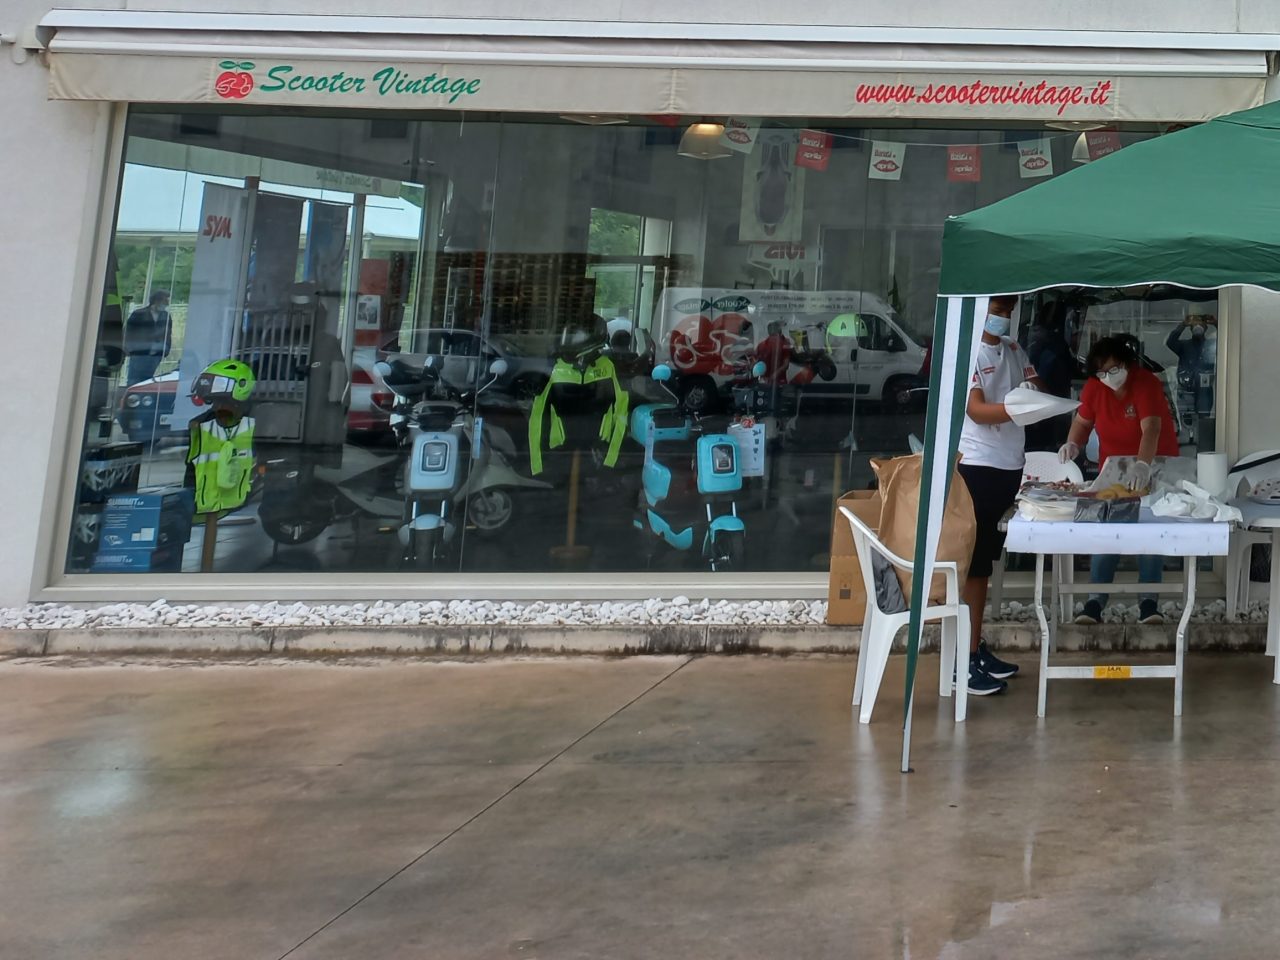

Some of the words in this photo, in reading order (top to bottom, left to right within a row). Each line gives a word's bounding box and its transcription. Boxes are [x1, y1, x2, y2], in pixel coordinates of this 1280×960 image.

[259, 65, 369, 94] Scooter
[373, 66, 481, 104] Vintage
[855, 79, 1112, 116] www.scootervintage.it
[202, 214, 233, 242] SYM
[764, 244, 806, 260] GIVI
